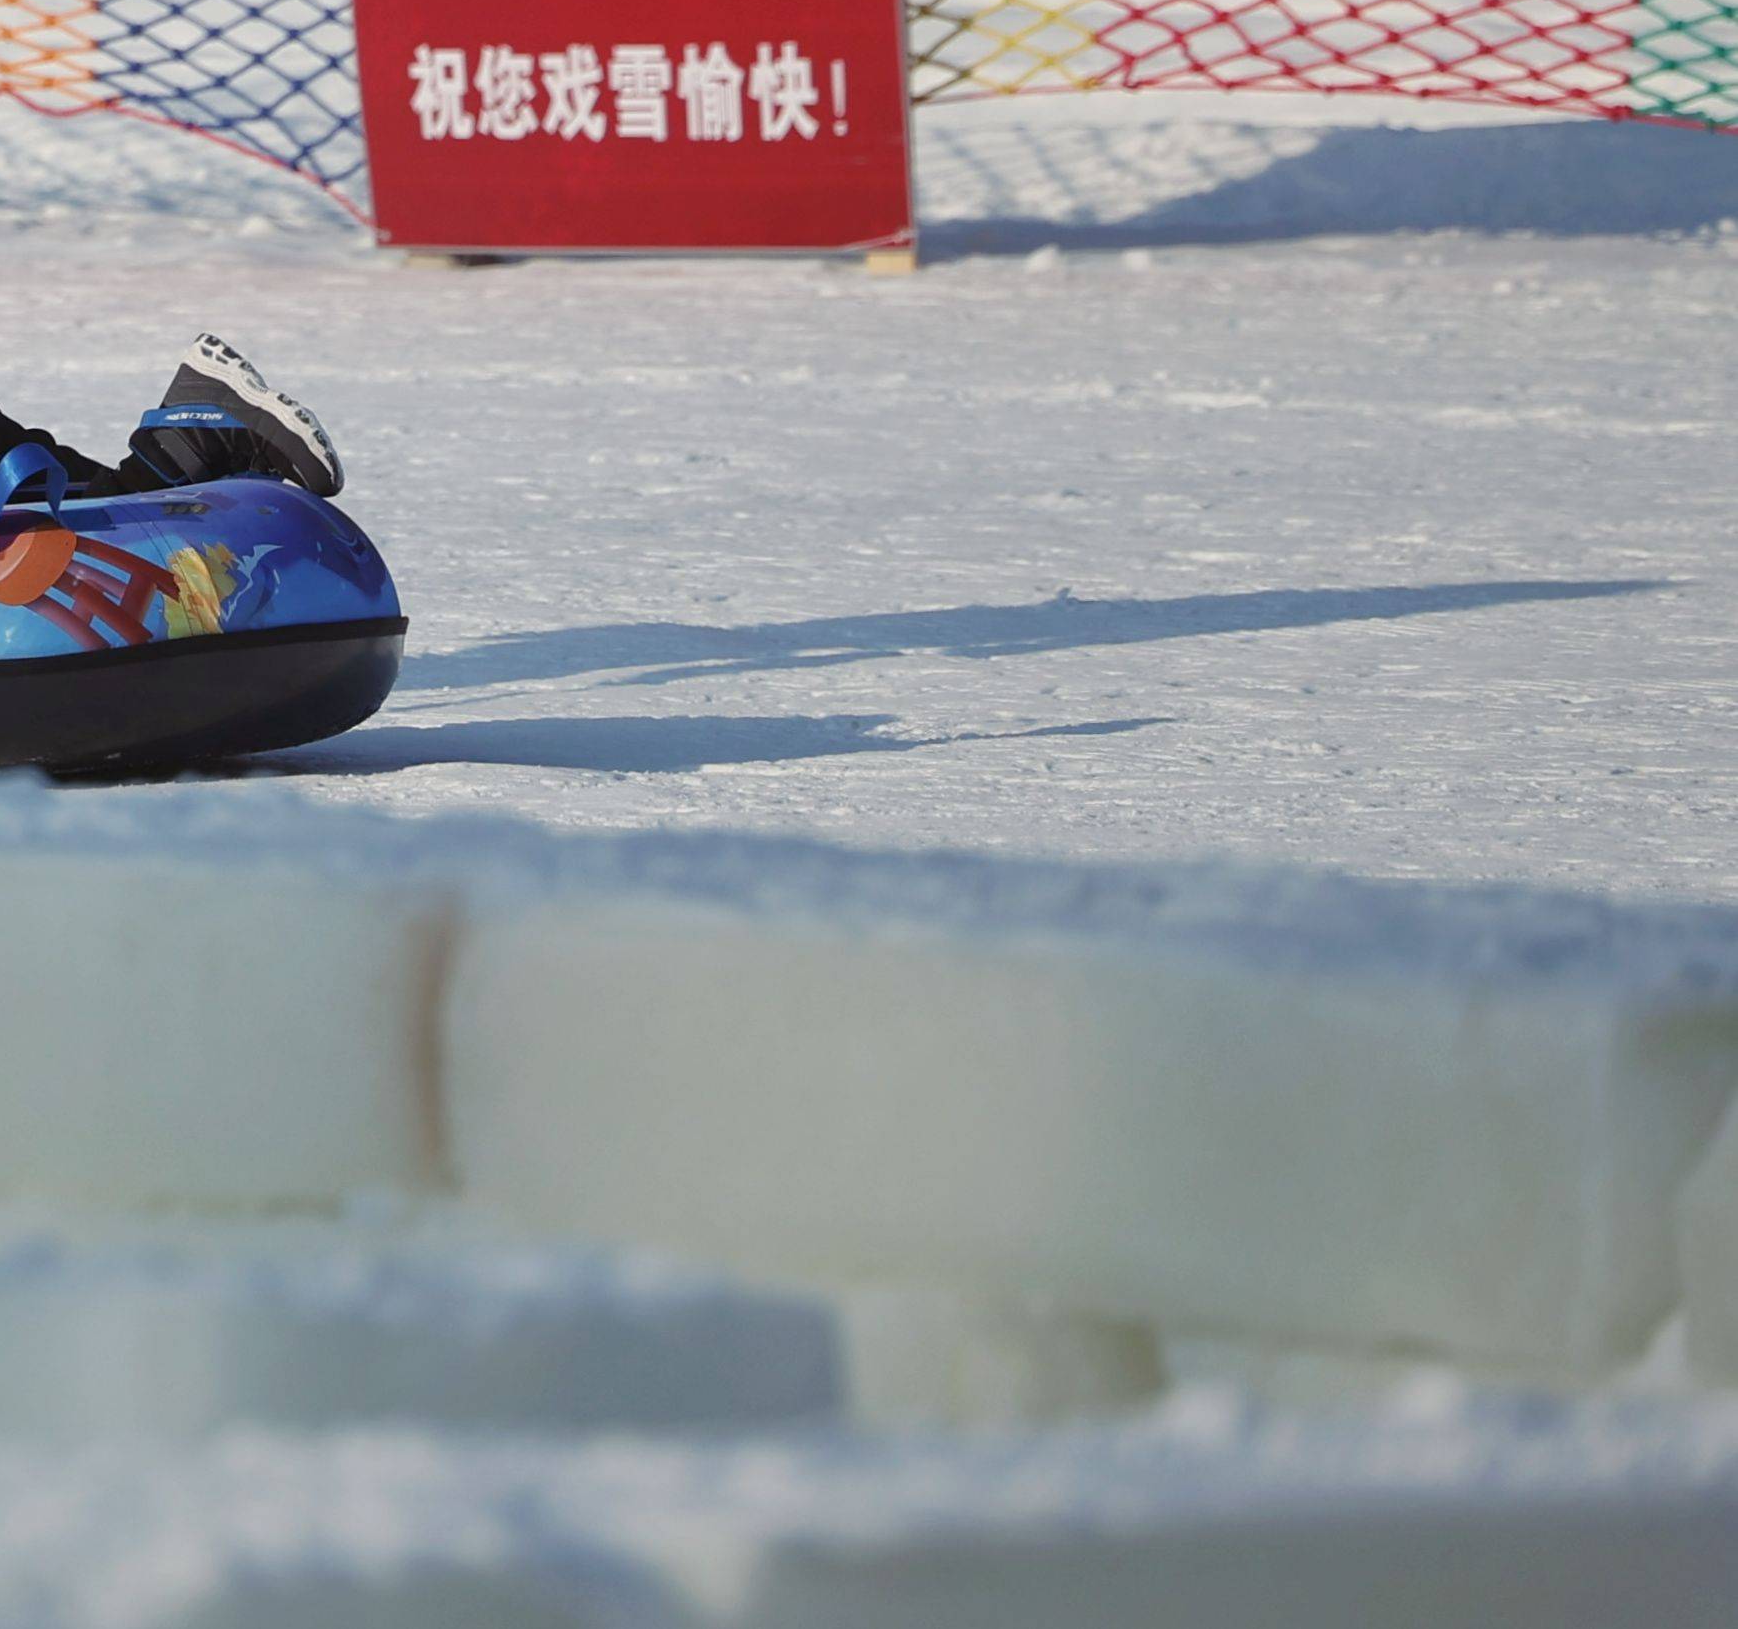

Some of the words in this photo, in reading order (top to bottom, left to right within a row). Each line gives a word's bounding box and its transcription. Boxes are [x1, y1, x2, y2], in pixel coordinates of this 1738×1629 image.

[408, 42, 848, 142] 祝您戏雪愉快！
